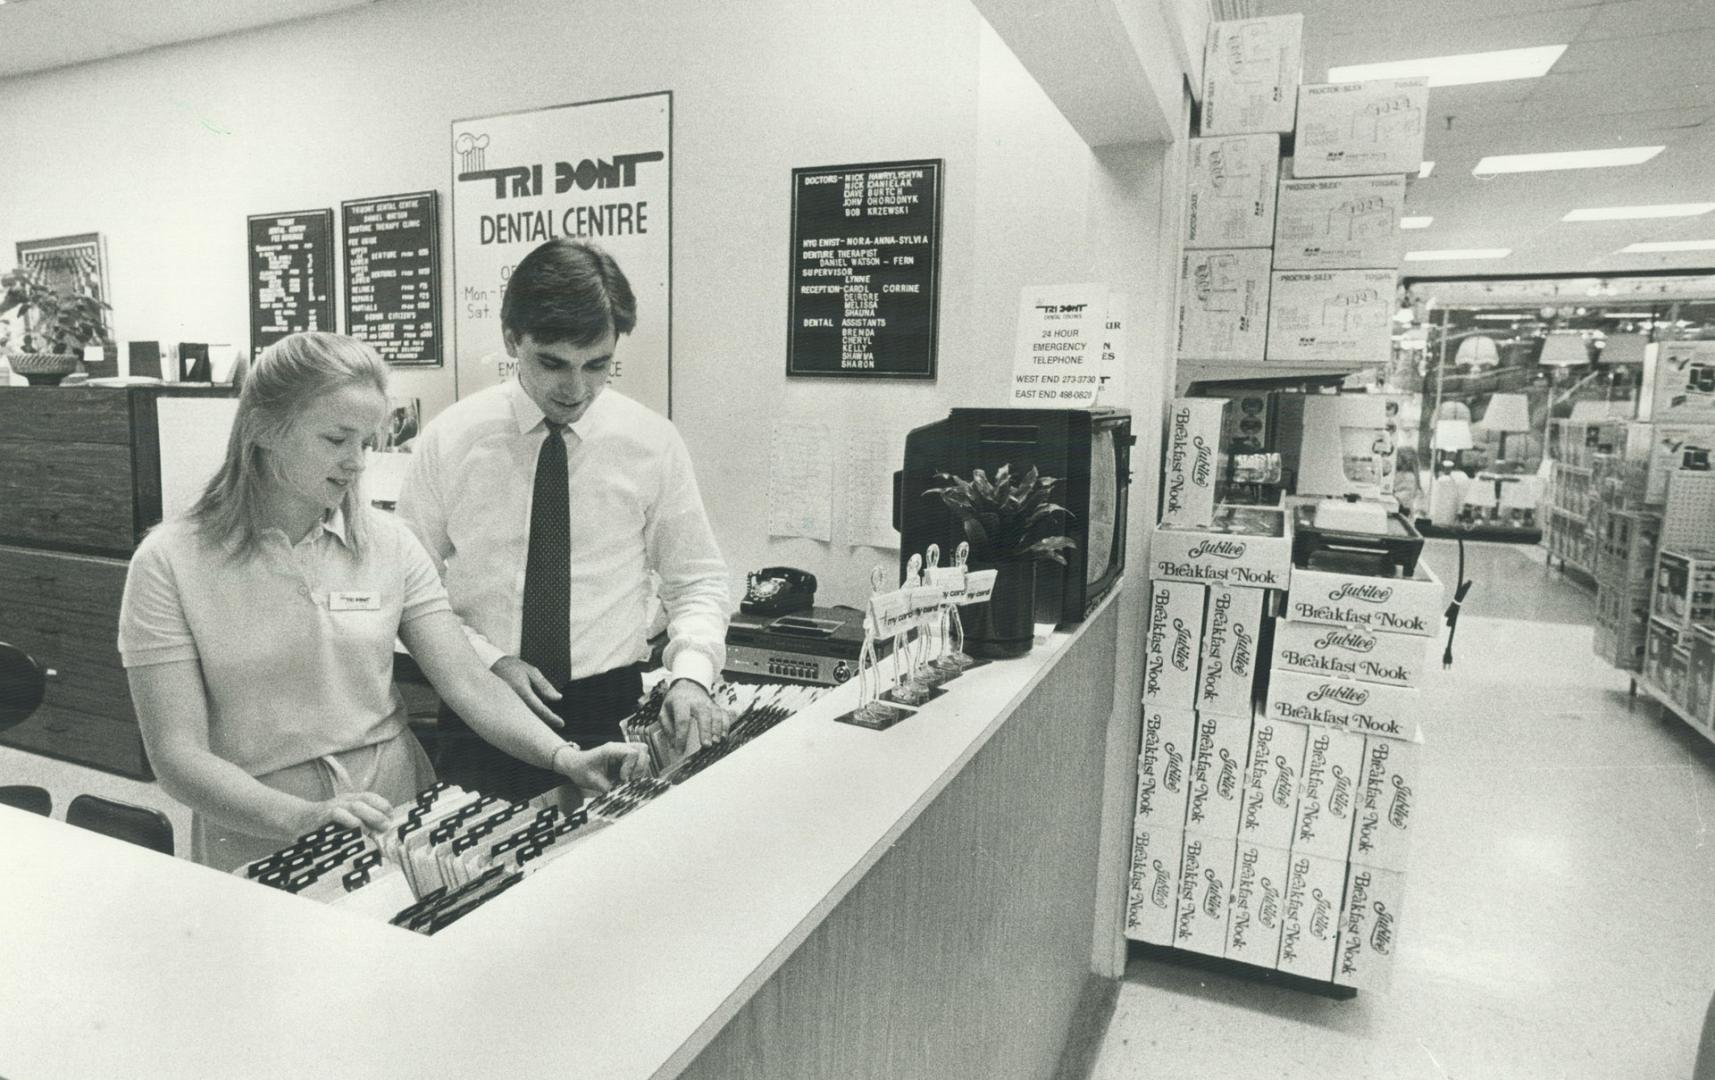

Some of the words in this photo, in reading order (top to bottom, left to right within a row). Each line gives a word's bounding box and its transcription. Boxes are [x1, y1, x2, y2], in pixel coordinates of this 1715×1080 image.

[844, 190, 864, 198] DAVE
[845, 174, 864, 182] NICK
[867, 179, 912, 188] DANIELAK
[481, 210, 558, 245] DENTAL
[563, 202, 647, 238] CENTRE
[845, 208, 860, 216] BOB
[868, 206, 908, 215] KRZEWSKI
[802, 268, 853, 277] SUPERVISOR
[803, 251, 834, 259] DENTURE
[838, 249, 878, 258] THERAPIST
[820, 259, 847, 267] DANIEL
[851, 258, 880, 266] WATSON
[894, 257, 914, 265] FERN
[844, 285, 869, 293] CAROL
[883, 285, 920, 293] CORRINE
[844, 293, 879, 301] DEIRDRE
[845, 275, 871, 283] LYNNE
[804, 319, 834, 327] DENTAL
[842, 318, 886, 327] ASSISTANTS
[842, 328, 875, 336] BRENDA
[1054, 329, 1079, 337] HOUR
[1033, 343, 1087, 351] EMERGENCY
[1033, 356, 1084, 364] TELEPHONE
[1015, 390, 1036, 398] EAST
[1039, 390, 1056, 398] END
[1016, 375, 1039, 383] WEST
[1171, 408, 1190, 474] Breakfast
[1168, 474, 1184, 514] Nook
[1188, 540, 1247, 560] Jubilee
[1158, 562, 1230, 580] Breakfast
[1231, 568, 1280, 584] Nook
[1329, 582, 1393, 603] Jubilee
[1151, 589, 1169, 653] Breakfast
[1211, 592, 1231, 659] Breakfast
[1295, 603, 1374, 624] Breakfast
[1375, 612, 1428, 631] Nook
[1314, 631, 1376, 653] Jubilee
[1147, 654, 1164, 698] Nook
[1203, 660, 1223, 703] Nook
[1281, 650, 1356, 673] Breakfast
[1359, 661, 1411, 681] Nook
[1307, 683, 1370, 706] Jubilee
[1274, 701, 1349, 726] Breakfast
[1351, 712, 1403, 734] Nook
[1143, 714, 1161, 774] Breakfast
[1196, 718, 1217, 781] Breakfast
[1251, 725, 1273, 789] Breakfast
[1307, 734, 1329, 798] Breakfast
[1364, 743, 1389, 810] Breakfast
[1139, 774, 1157, 816] Nook
[1190, 781, 1209, 823] Nook
[1245, 789, 1264, 831] Nook
[1300, 799, 1321, 842] Nook
[1358, 810, 1379, 854] Nook
[1130, 832, 1149, 890] Breakfast
[1181, 840, 1201, 900] Breakfast
[1236, 848, 1258, 910] Breakfast
[1286, 858, 1309, 921] Breakfast
[1347, 871, 1371, 933] Breakfast
[1128, 890, 1145, 931] Nook
[1178, 899, 1197, 942] Nook
[1232, 910, 1250, 951] Nook
[1282, 921, 1302, 964] Nook
[1342, 933, 1361, 974] Nook
